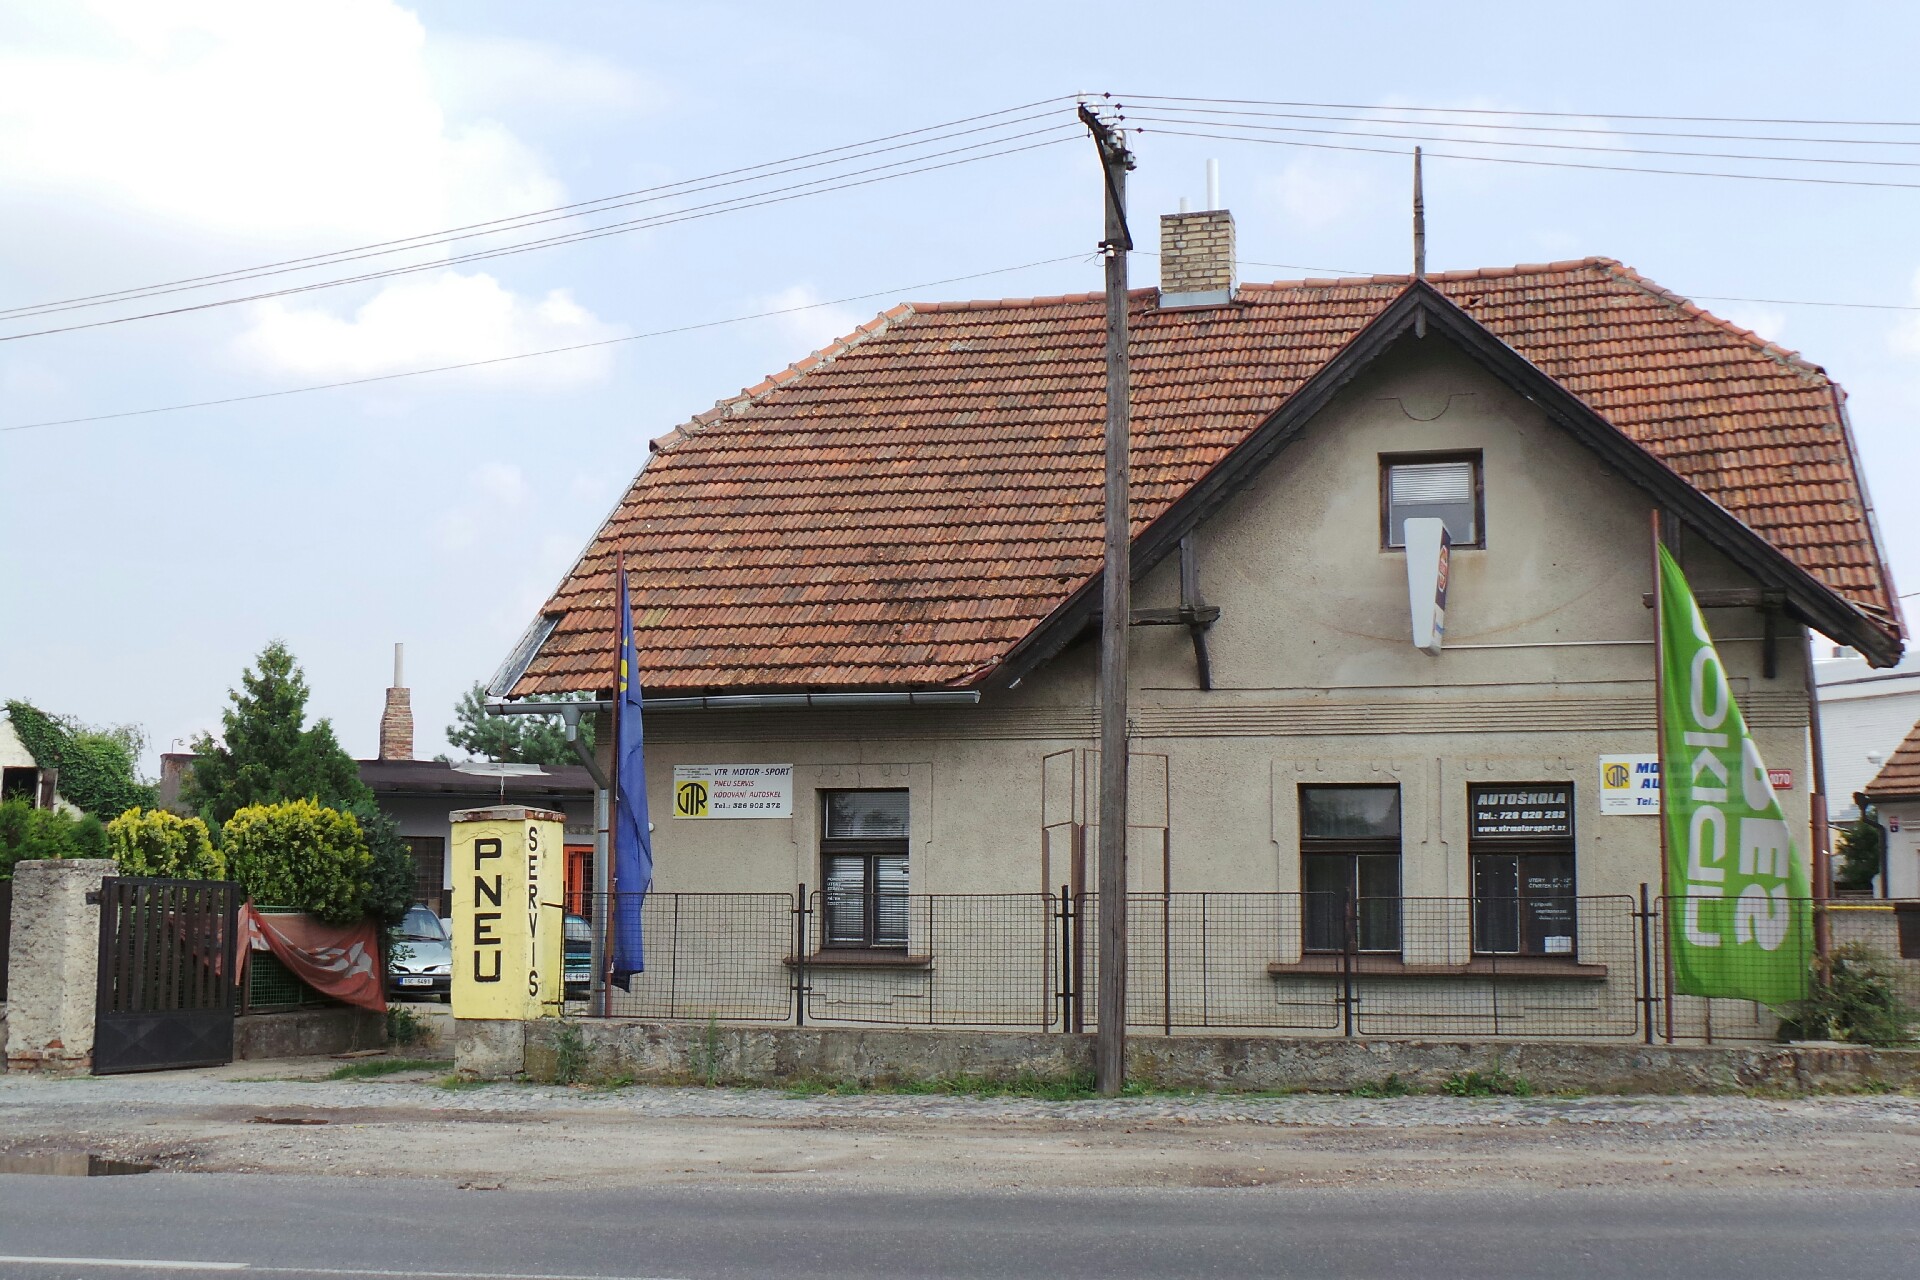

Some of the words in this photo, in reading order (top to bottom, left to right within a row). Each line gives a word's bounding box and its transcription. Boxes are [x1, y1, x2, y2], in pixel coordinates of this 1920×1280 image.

[714, 768, 728, 776] VTR
[1769, 773, 1790, 785] 1070
[1477, 791, 1566, 805] AUTOŠKOLA
[1478, 824, 1566, 833] www.vtrmotorsport.cz
[474, 837, 502, 983] PNEU
[528, 826, 539, 997] SERVIS
